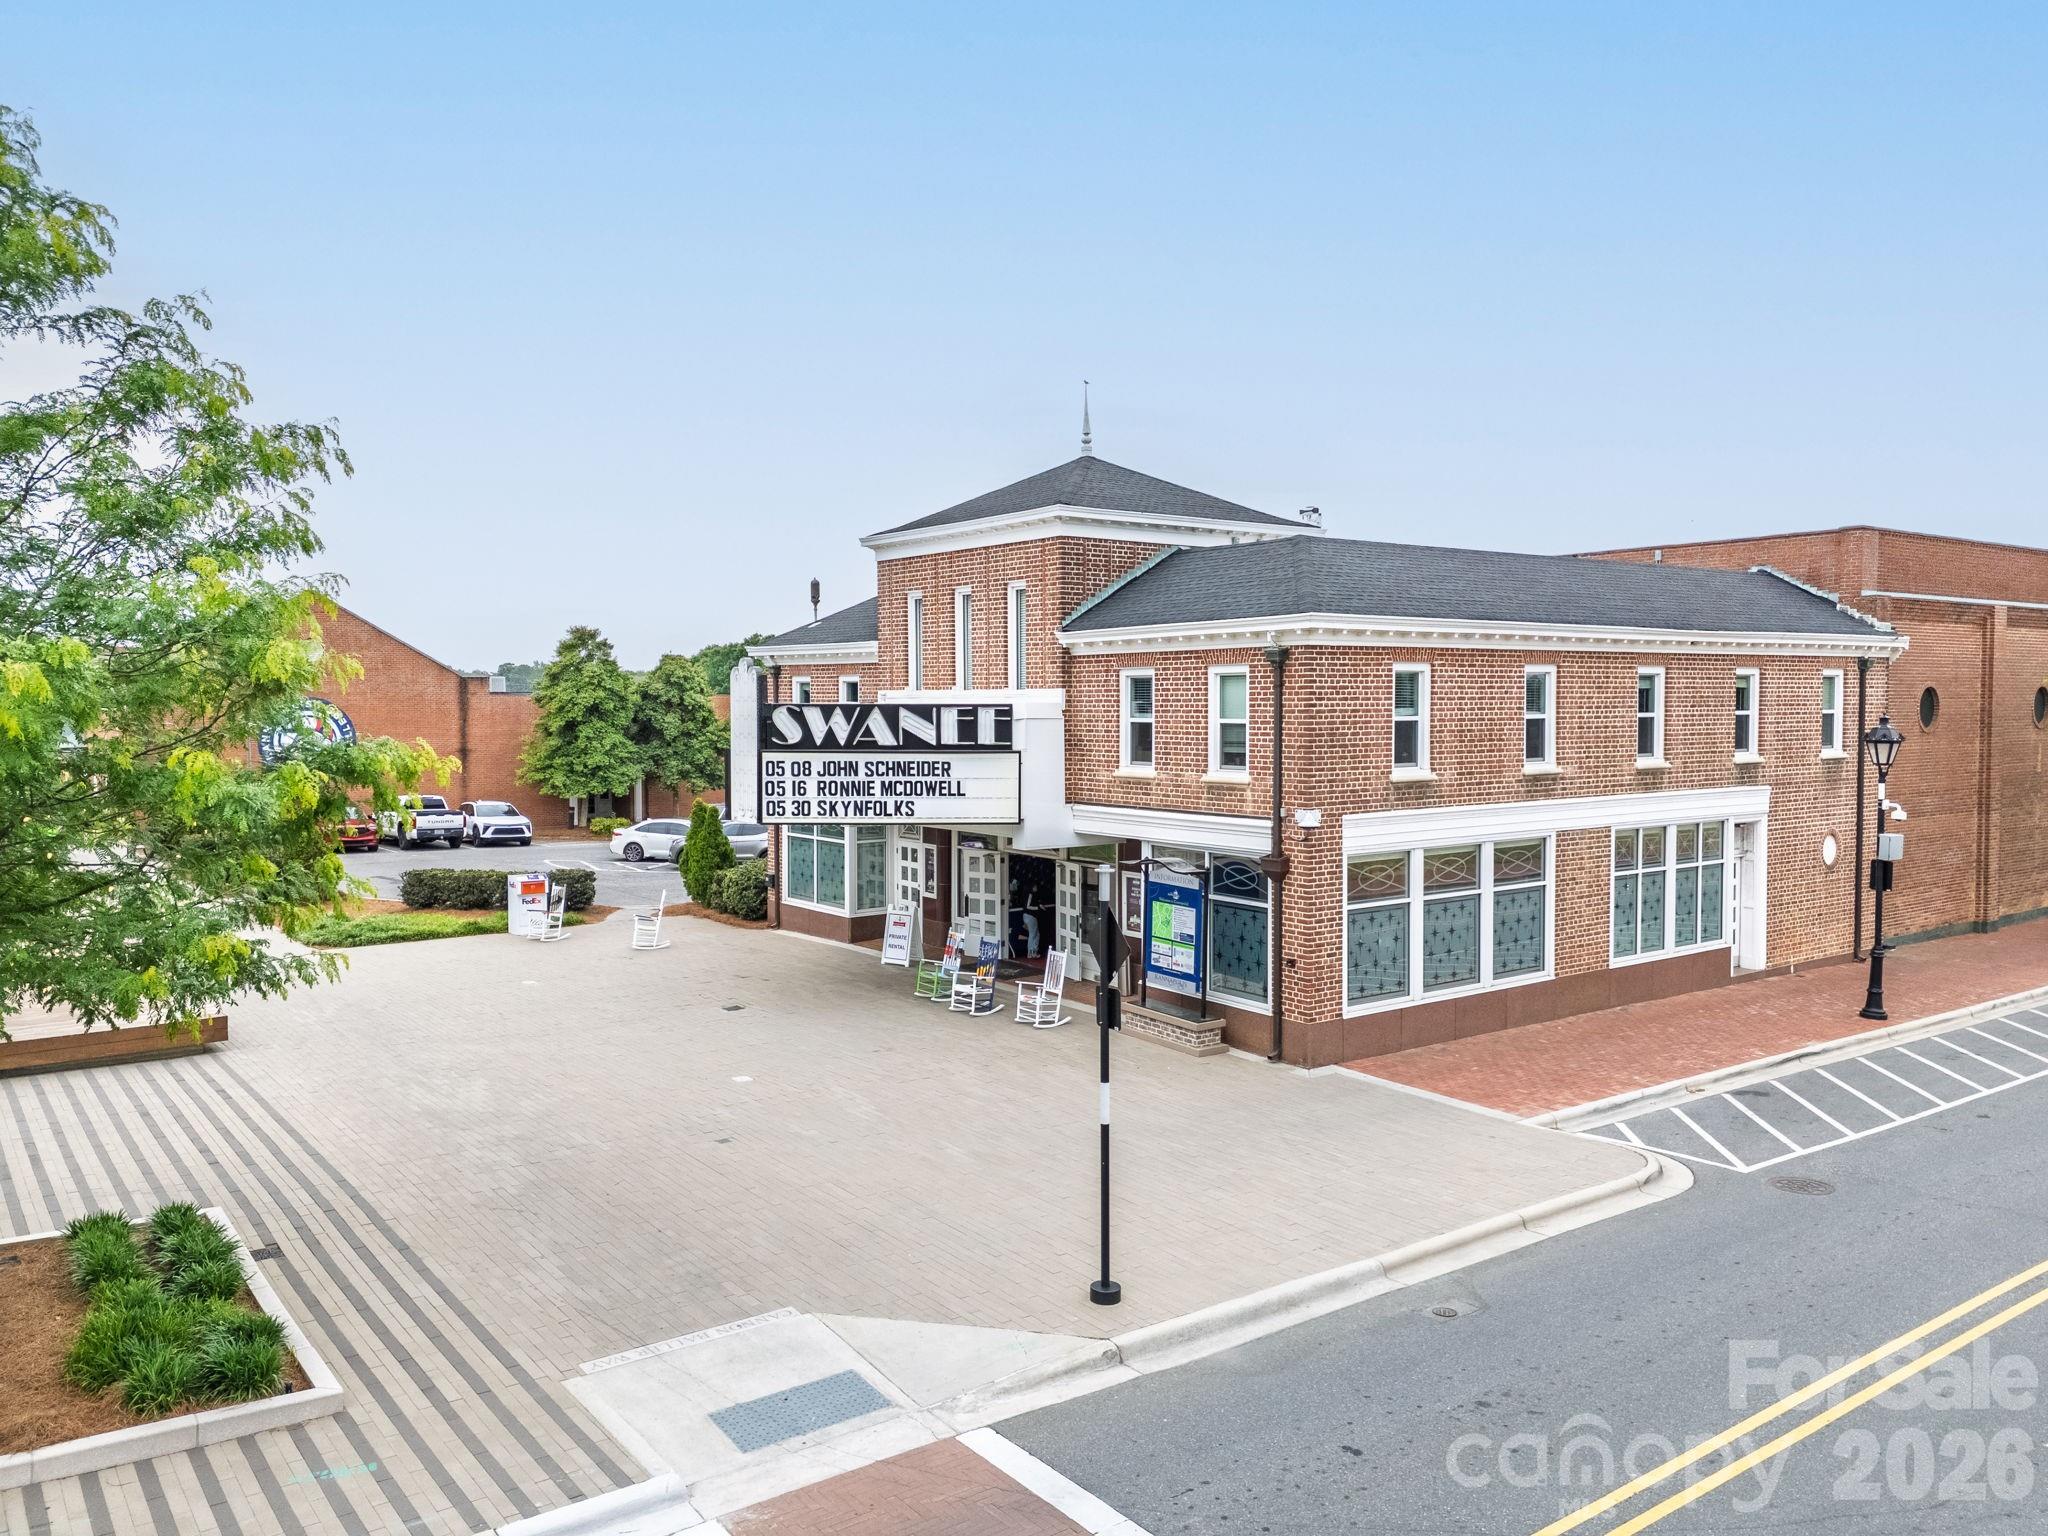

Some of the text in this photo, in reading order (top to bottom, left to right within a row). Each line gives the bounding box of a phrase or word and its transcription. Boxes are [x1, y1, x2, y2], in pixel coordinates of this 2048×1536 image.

[771, 705, 1012, 746] SWANEE
[765, 761, 951, 777] 05 08 JOHN SCHNEIDER
[765, 780, 966, 797] 05 16 RONNIE MCDOWELL
[766, 800, 915, 817] 05 30 SKYNFOLKS
[522, 897, 542, 905] FedEx
